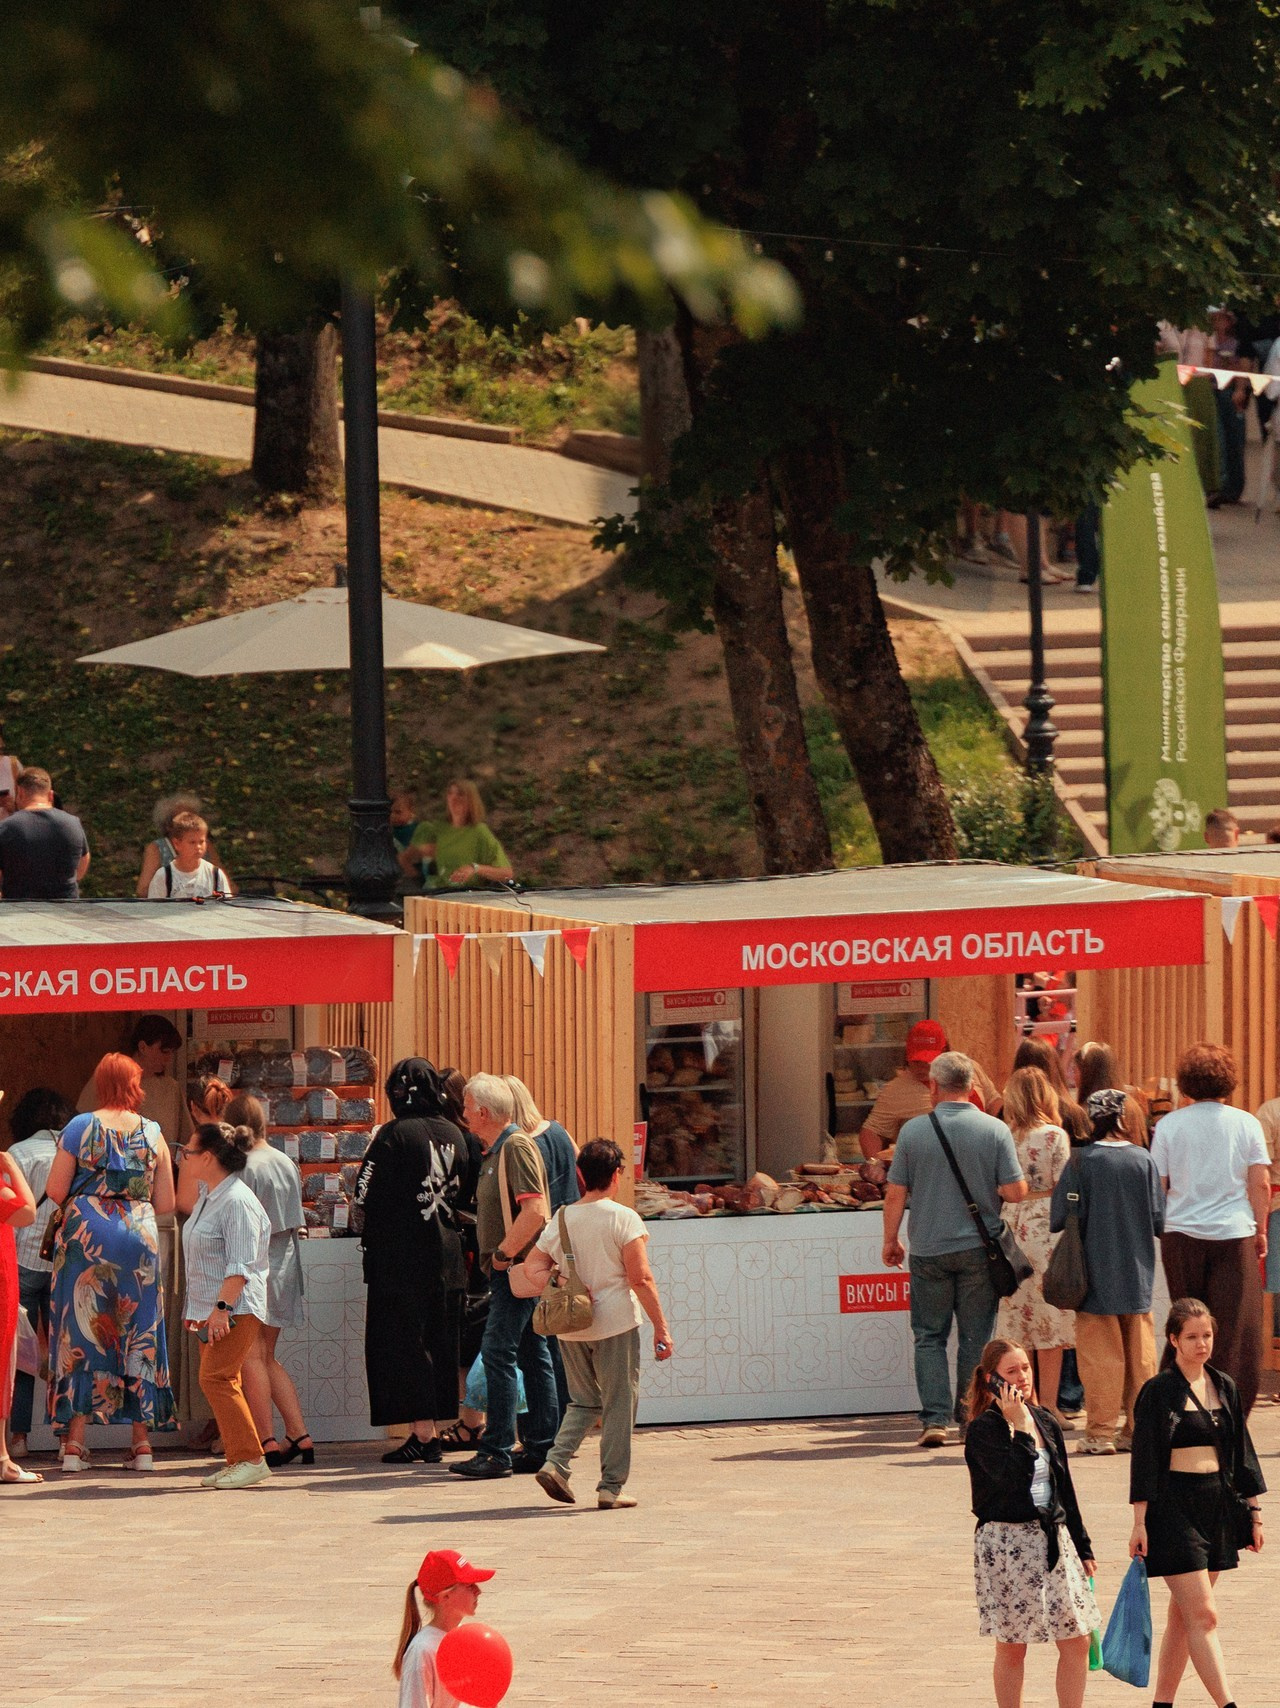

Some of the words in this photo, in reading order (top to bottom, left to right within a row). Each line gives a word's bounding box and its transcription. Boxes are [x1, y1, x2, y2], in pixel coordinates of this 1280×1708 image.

[1150, 472, 1167, 553] хозяйства
[1158, 556, 1171, 640] сельского
[1173, 567, 1189, 663] Федерации
[1160, 643, 1173, 763] Министерство
[1174, 667, 1188, 763] Российской
[89, 965, 248, 995] ОБЛАСТЬ
[742, 936, 952, 971] МОСКОВСКАЯ
[961, 928, 1105, 959] ОБЛАСТЬ
[846, 1282, 897, 1304] ВКУСЫ
